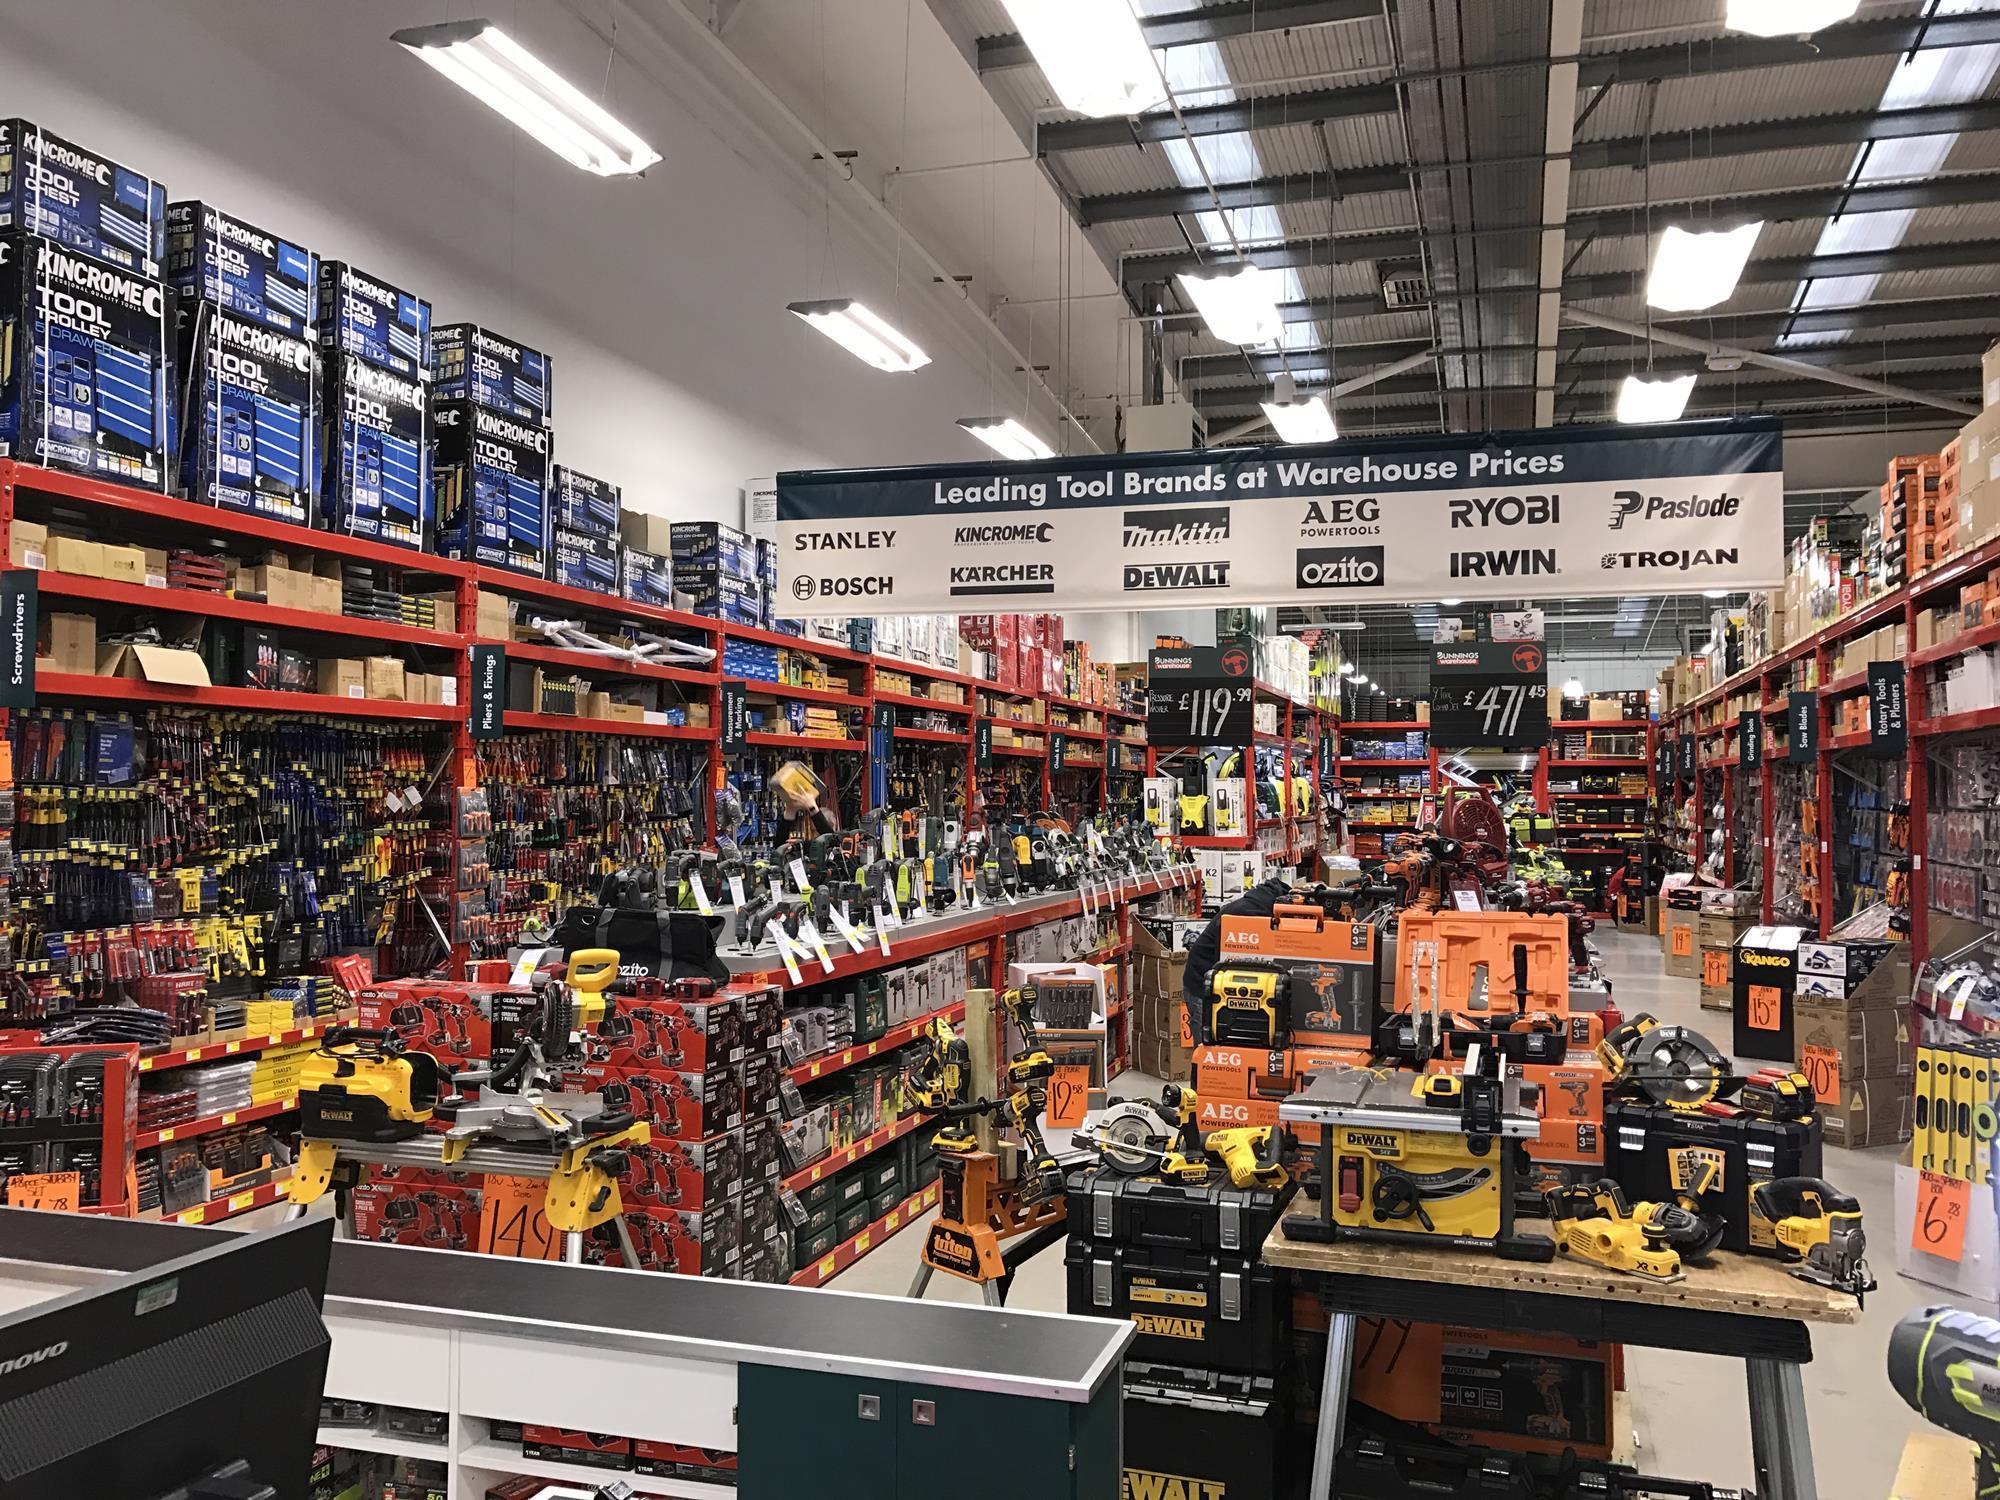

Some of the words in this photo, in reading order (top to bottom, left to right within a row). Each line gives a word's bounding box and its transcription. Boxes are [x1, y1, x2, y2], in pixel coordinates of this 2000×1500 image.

[23, 132, 97, 178] KINCROME
[25, 161, 80, 196] TOOL
[25, 179, 80, 208] CHEST
[204, 212, 262, 250] KINCROME
[205, 239, 249, 268] TOOL
[205, 253, 249, 276] CHEST
[38, 248, 143, 307] KINCROME
[342, 271, 387, 301] KINCROME
[36, 270, 89, 295] PROFESSIONAL
[91, 291, 119, 305] QUALITY
[121, 301, 141, 312] TOOLS
[36, 286, 111, 328] TOOL
[342, 307, 376, 328] CHEST
[343, 294, 376, 320] TOOL
[36, 306, 110, 340] TROLLEY
[35, 321, 44, 333] 5
[51, 324, 113, 354] DRAWER
[211, 314, 296, 364] KINCROME
[439, 341, 464, 350] CHEST
[472, 332, 513, 357] KINCROME
[209, 349, 268, 384] TOOL
[473, 353, 503, 373] TOOL
[473, 363, 503, 381] CHEST
[208, 367, 267, 394] TROLLEY
[345, 362, 414, 400] KINCROME
[208, 380, 215, 391] 5
[221, 384, 269, 407] DRAWER
[345, 393, 393, 424] TOOL
[345, 410, 392, 433] TROLLEY
[476, 411, 536, 445] KINCROME
[476, 454, 517, 474] TROLLEY
[477, 439, 517, 465] TOOL
[935, 478, 1046, 507] Leading
[1057, 474, 1113, 498] Tool
[1125, 467, 1226, 494] Brands
[1237, 467, 1267, 489] at
[1276, 456, 1457, 487] Warehouse
[1469, 449, 1564, 476] Prices
[1301, 499, 1381, 524] AEG
[1449, 495, 1560, 529] RYOBI
[1644, 492, 1741, 520] Paslode
[672, 525, 701, 533] KINCROME
[795, 531, 897, 551] STANLEY
[955, 524, 1037, 543] KINCROME
[1300, 525, 1381, 537] POWERTOOLS
[1301, 555, 1379, 585] ozito
[1450, 549, 1557, 578] IRWIN
[1619, 548, 1740, 571] TROJAN
[950, 563, 1054, 584] KÄRCHER
[820, 577, 893, 596] BOSCH
[1842, 583, 1854, 614] RYOBI
[11, 593, 25, 685] Screwdrivers
[483, 654, 497, 689] Fixings
[1154, 656, 1192, 664] BUNNINGS
[483, 692, 493, 700] &
[1877, 678, 1886, 705] Tools
[1890, 683, 1900, 718] Planers
[482, 703, 493, 730] Pliers
[735, 697, 745, 729] Marking
[1800, 706, 1808, 731] Blades
[1878, 706, 1888, 735] Rotary
[1890, 720, 1900, 729] &
[735, 730, 742, 738] &
[1800, 732, 1808, 748] Saw
[1205, 868, 1217, 877] K2
[1225, 932, 1259, 944] AEG
[1352, 925, 1359, 934] 6
[1352, 937, 1359, 945] 3
[1708, 961, 1721, 983] 19
[1745, 953, 1791, 968] KANGO
[1574, 1019, 1580, 1028] 6
[1753, 998, 1770, 1025] 15
[1574, 1030, 1580, 1038] 3
[1202, 1065, 1242, 1073] POWERTOOLS
[1203, 1051, 1242, 1066] AEG
[1269, 1052, 1275, 1061] 6
[1269, 1063, 1275, 1072] 3
[1805, 1056, 1830, 1095] 20
[1053, 1081, 1074, 1120] 12
[1072, 1084, 1083, 1095] 58
[1201, 1103, 1249, 1120] AEG
[1578, 1125, 1586, 1135] 6
[1579, 1137, 1586, 1147] 3
[934, 1232, 972, 1261] triton
[1636, 1260, 1649, 1271] XR
[1464, 1390, 1475, 1398] 60
[1123, 1473, 1226, 1500] EWALT
